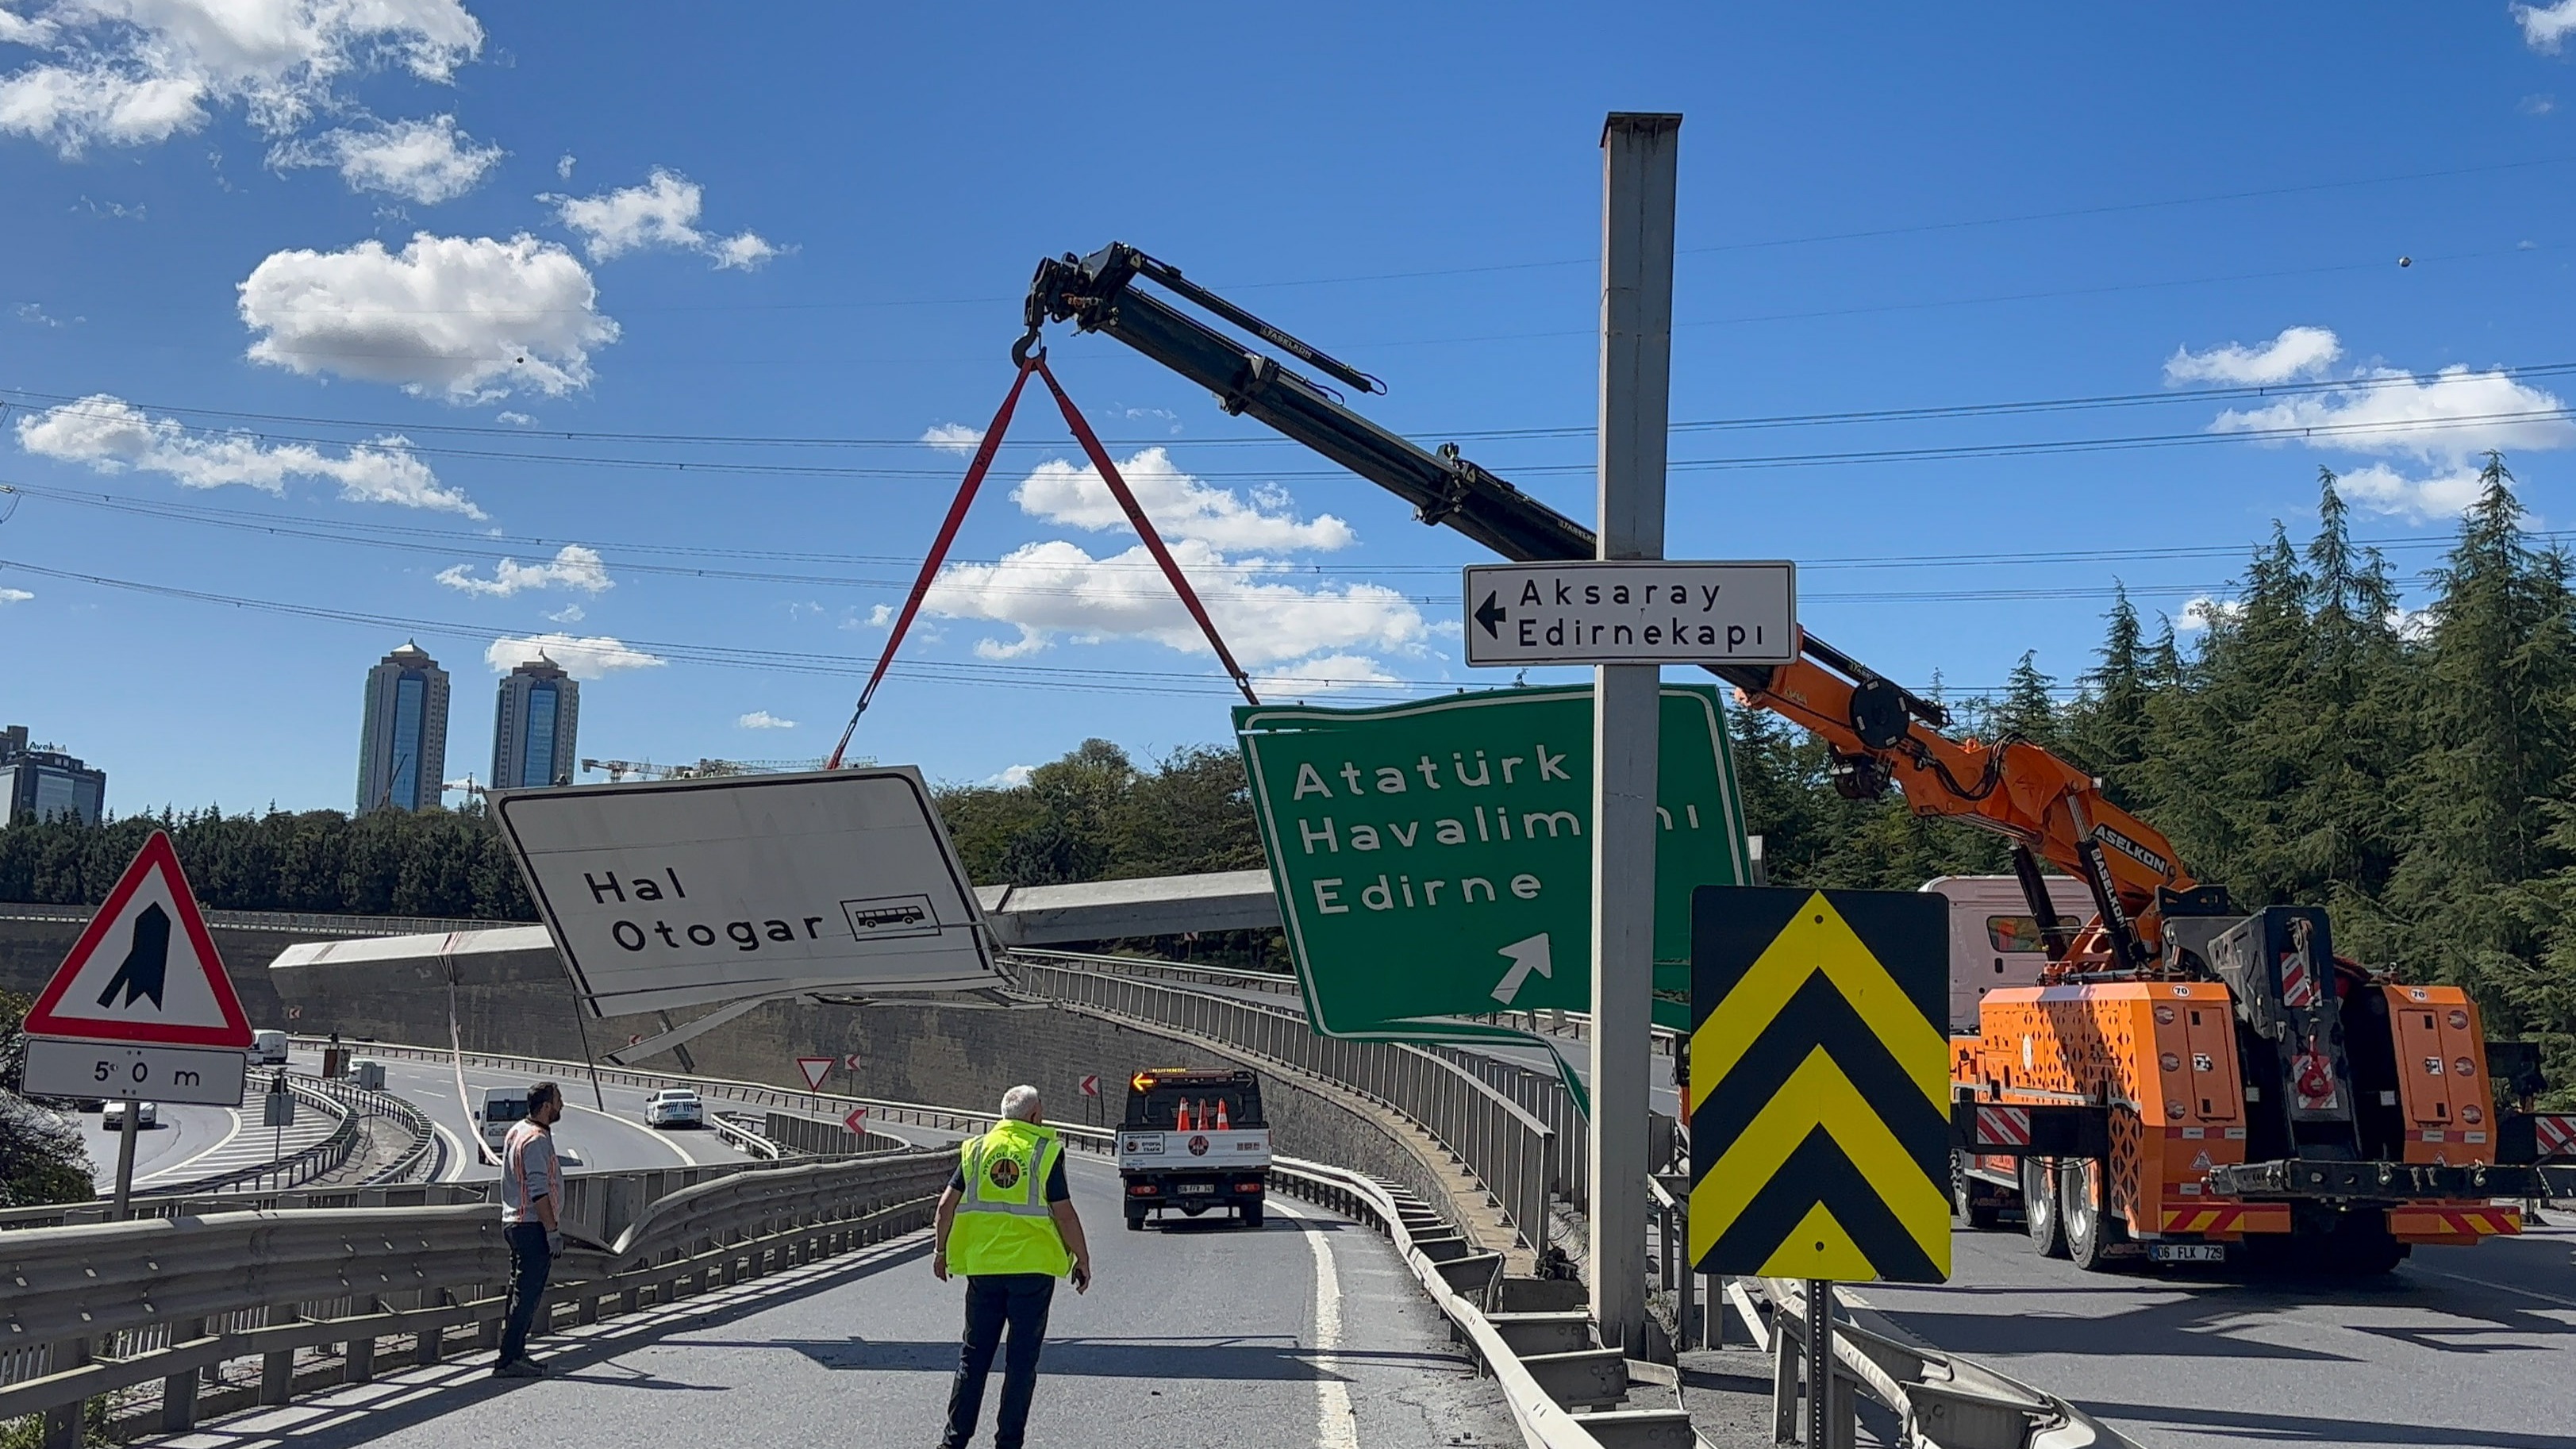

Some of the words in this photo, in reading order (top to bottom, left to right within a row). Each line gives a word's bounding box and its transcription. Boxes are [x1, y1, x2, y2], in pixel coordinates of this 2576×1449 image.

[1519, 578, 1721, 613] Aksaray
[1518, 617, 1763, 654] Edirnekapı
[1294, 744, 1571, 801] Atatürk
[1299, 805, 1700, 854] Havalimnı
[2094, 825, 2166, 873] ASELKON
[582, 867, 686, 905] Hal
[1313, 874, 1542, 914] Edirne
[2094, 859, 2127, 929] ASELKON
[612, 916, 824, 952] Otogar
[174, 1070, 201, 1088] m
[2159, 1246, 2170, 1259] 06
[2178, 1246, 2197, 1259] FLX
[2204, 1246, 2222, 1259] 729
